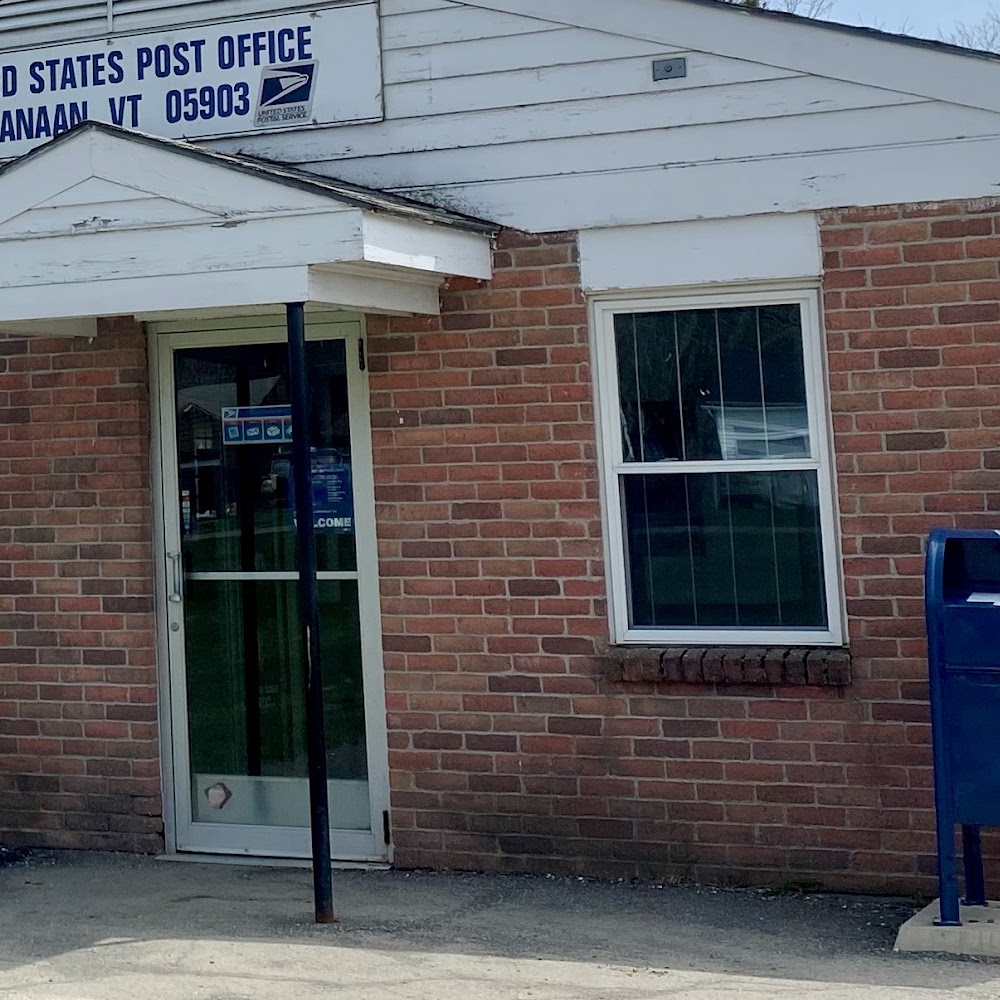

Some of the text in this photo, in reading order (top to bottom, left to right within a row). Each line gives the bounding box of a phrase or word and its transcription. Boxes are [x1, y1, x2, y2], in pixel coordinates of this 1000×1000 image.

[29, 50, 124, 95] STATES
[137, 39, 205, 81] POST
[218, 25, 312, 70] OFFICE
[109, 94, 142, 128] VT
[165, 81, 250, 124] 05903
[257, 111, 307, 123] POSTAL SERVICE
[258, 105, 305, 116] UNITED STATES
